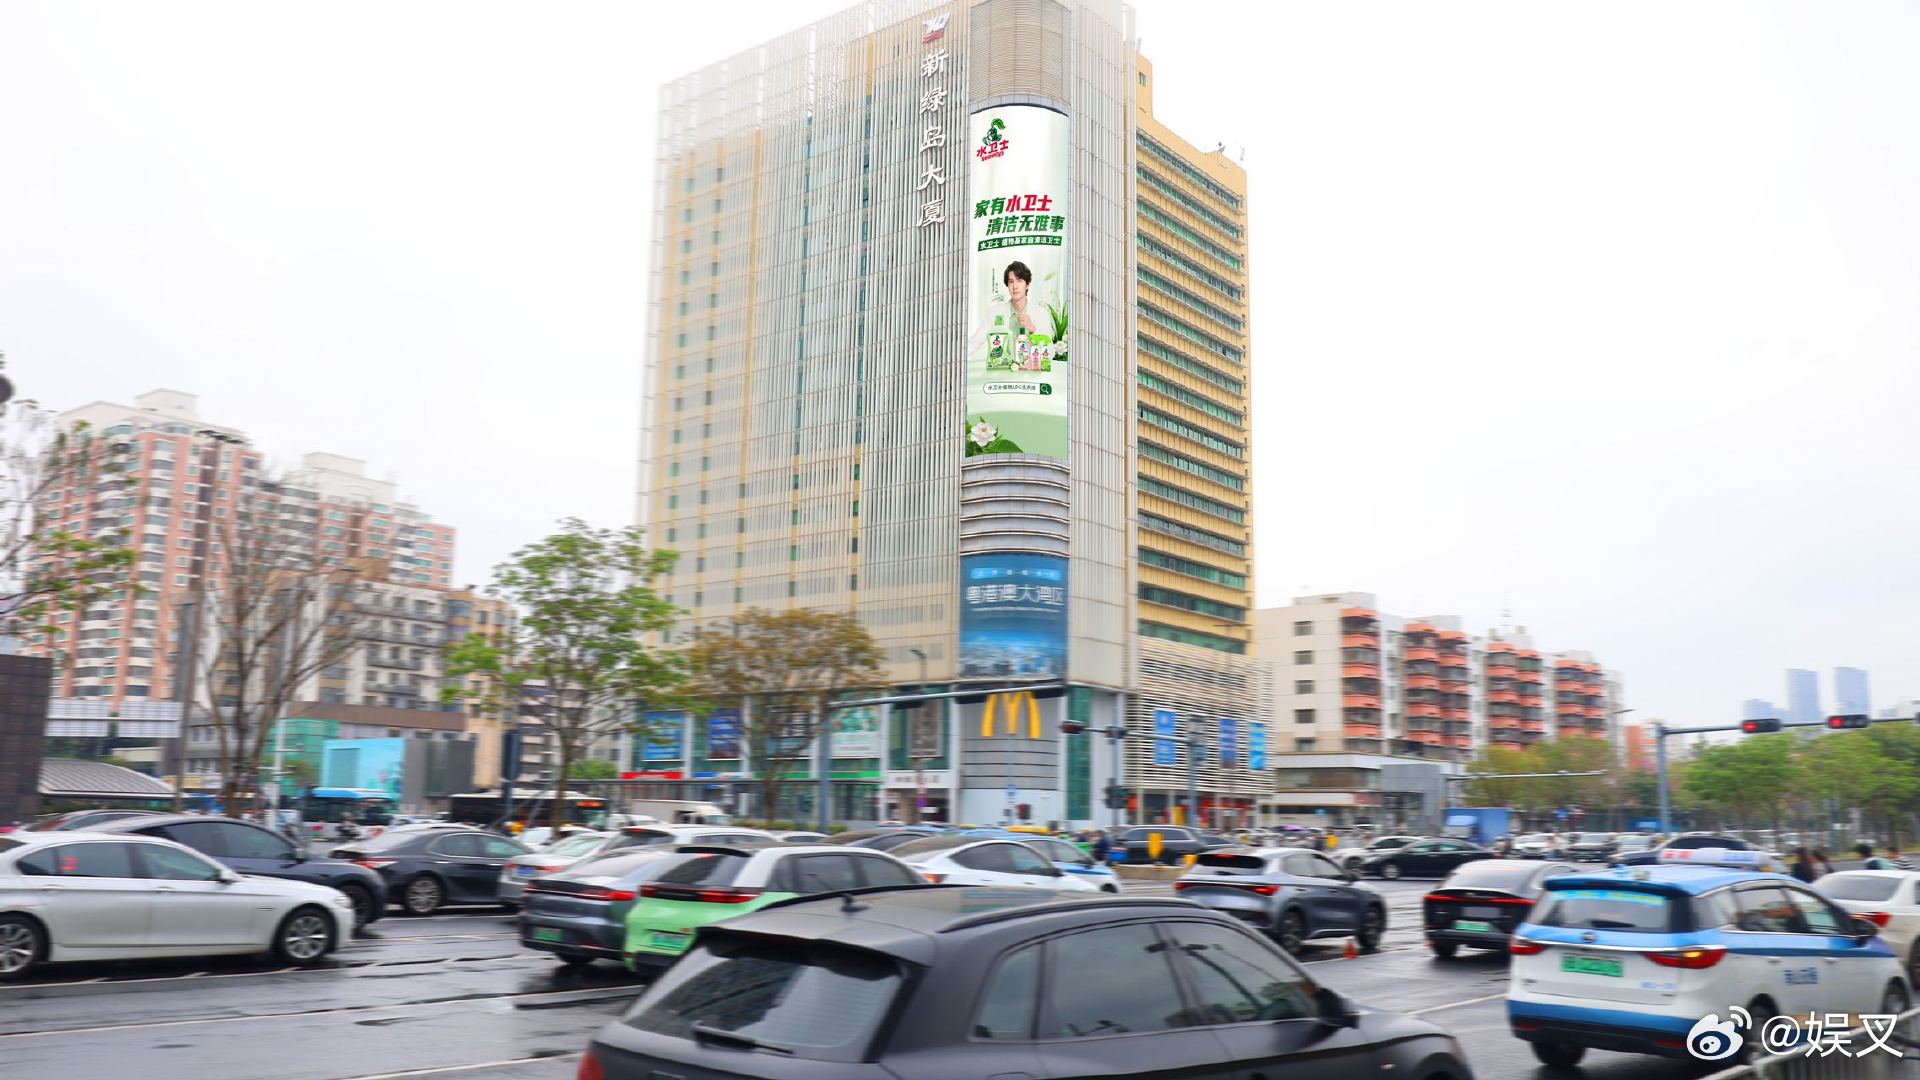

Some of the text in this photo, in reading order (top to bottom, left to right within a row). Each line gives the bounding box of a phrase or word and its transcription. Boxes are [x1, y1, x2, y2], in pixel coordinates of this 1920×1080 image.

[917, 49, 949, 228] 新绿岛大厦
[976, 139, 1009, 158] 水卫士
[974, 194, 1053, 219] 家有水卫士
[985, 214, 1065, 236] 清洁无难事
[979, 240, 1000, 249] 水卫士
[966, 584, 1064, 606] 粤港澳大湾区
